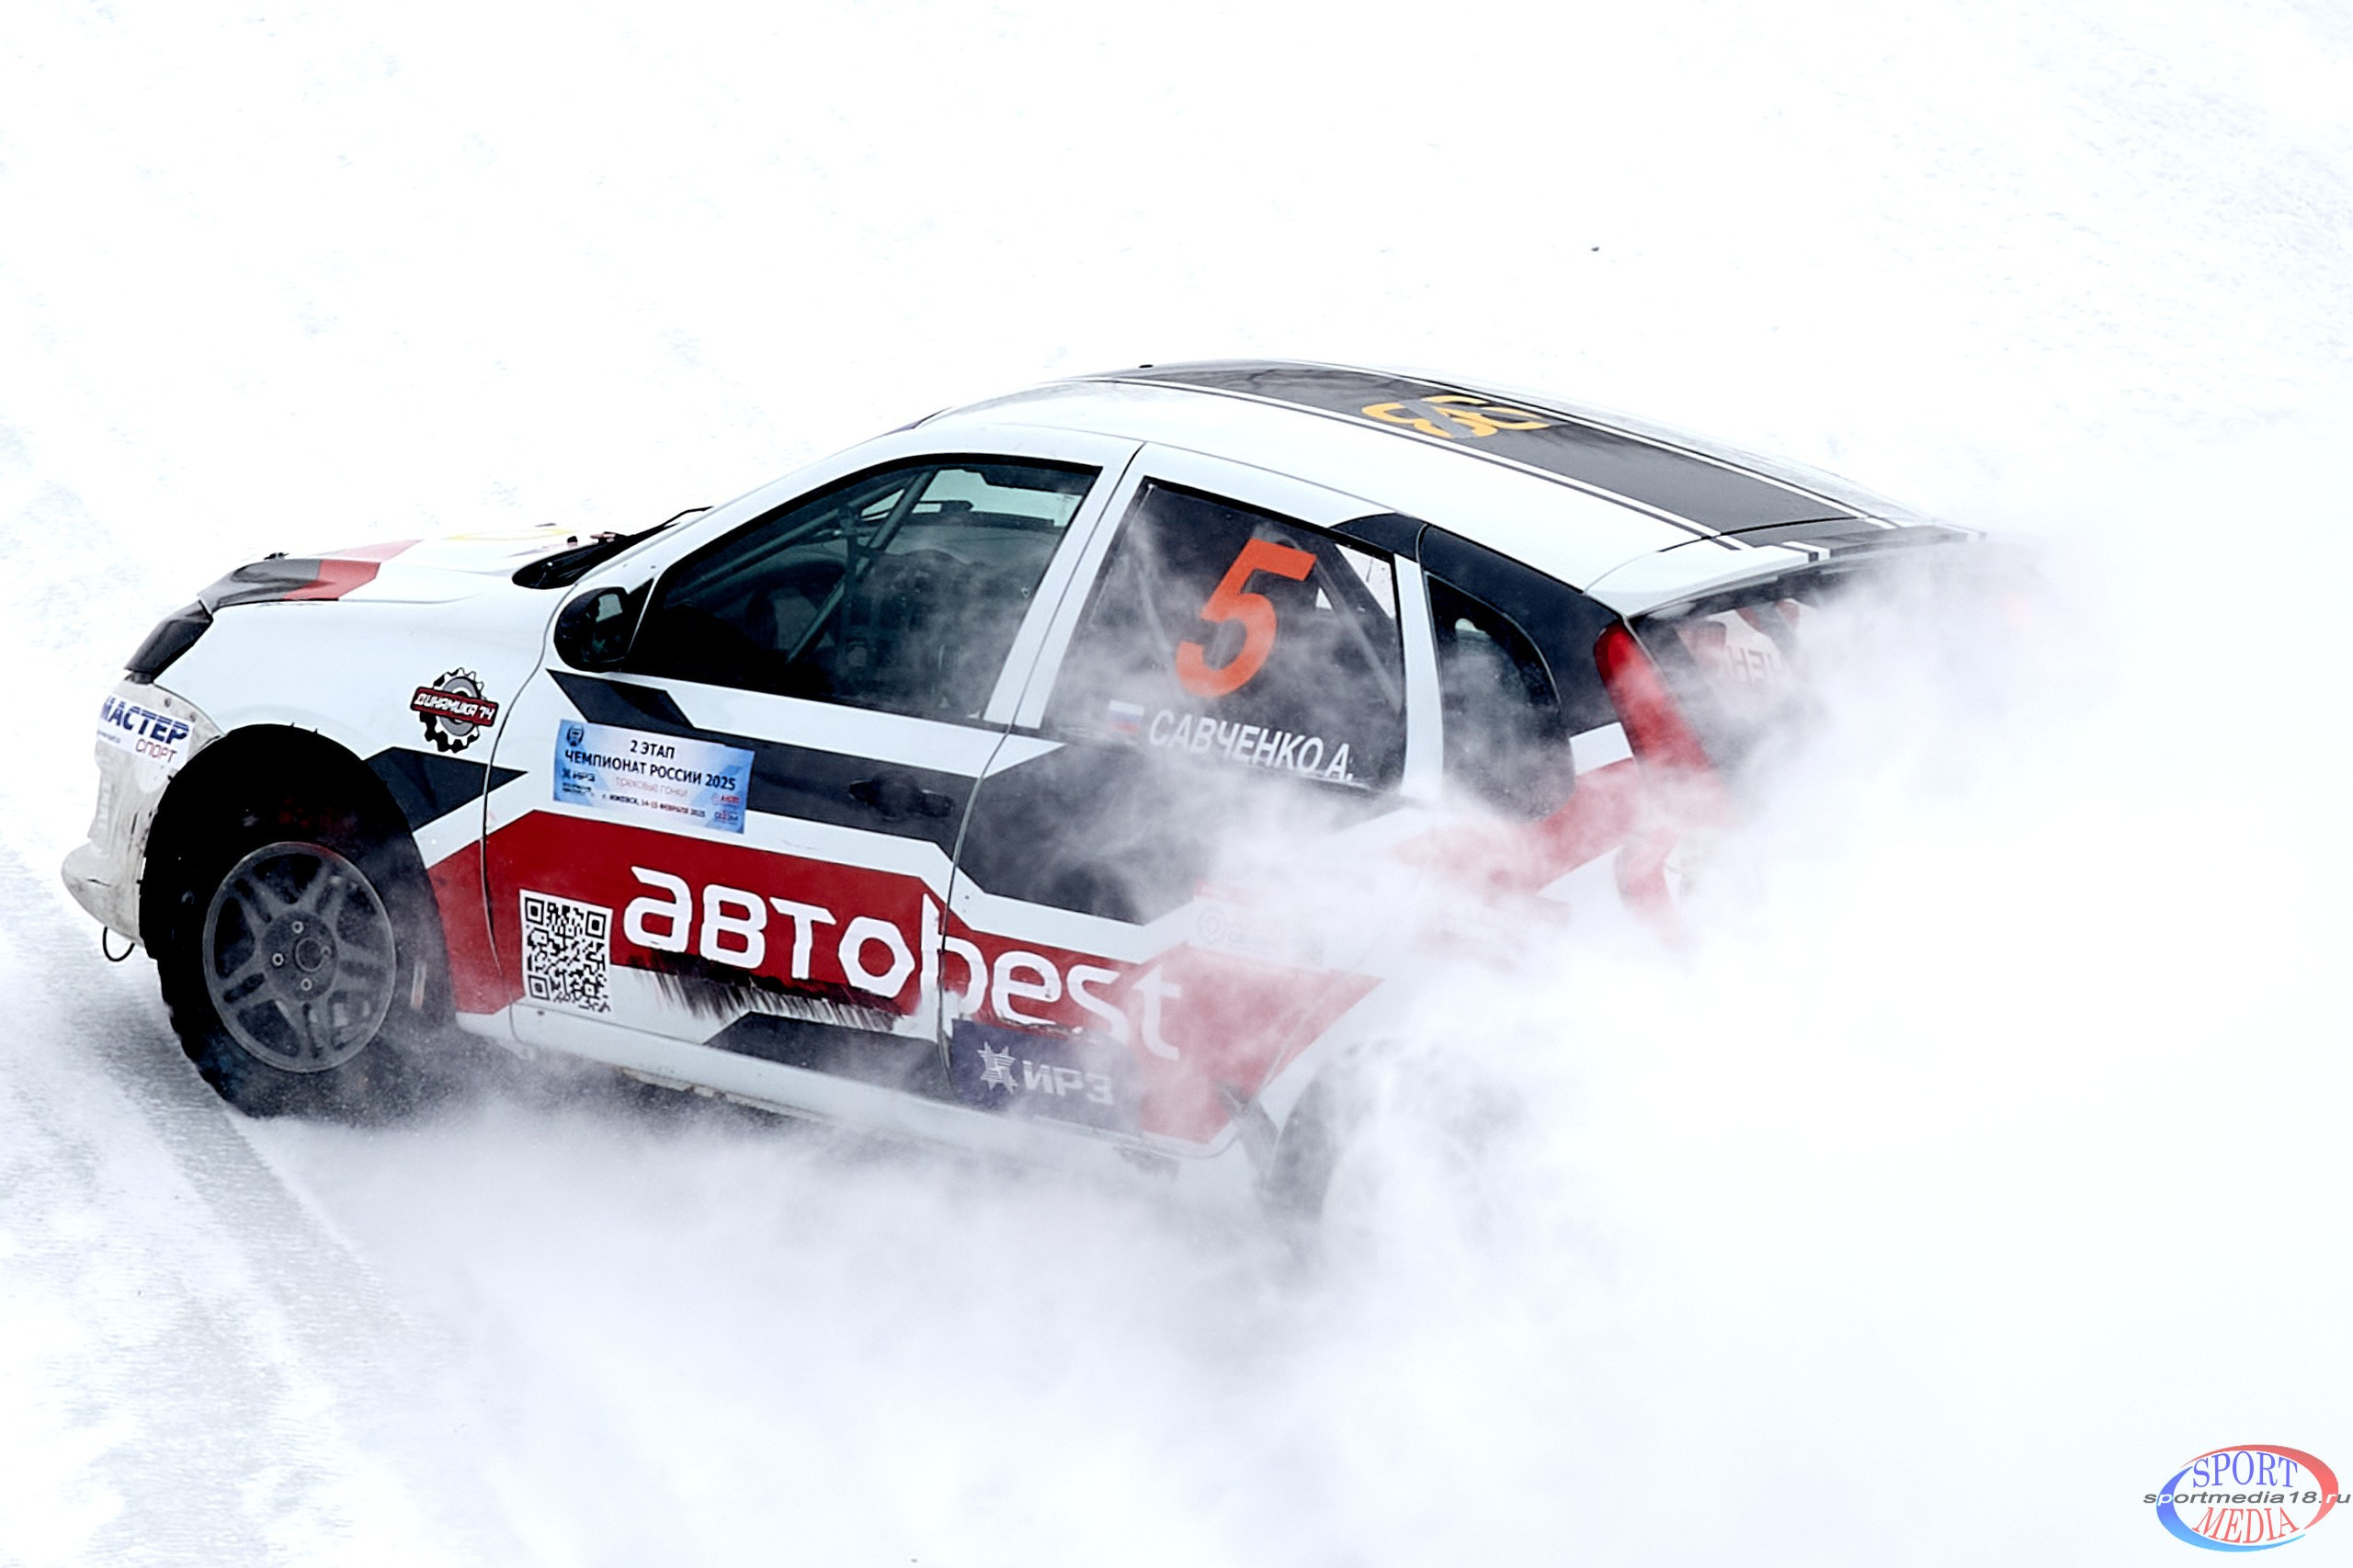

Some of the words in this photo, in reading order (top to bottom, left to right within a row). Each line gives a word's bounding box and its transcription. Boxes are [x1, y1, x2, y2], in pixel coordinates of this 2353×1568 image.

[1175, 538, 1318, 699] 5
[135, 738, 177, 763] СПОРТ
[630, 739, 638, 754] 2
[642, 741, 676, 760] ЭТАП
[1149, 709, 1324, 774] САВЧЕНКО
[564, 749, 647, 775] ЧЕМПИОНАТ
[649, 763, 701, 786] РОССИИ
[705, 773, 736, 791] 2025
[1021, 1059, 1115, 1105] ИРЗ
